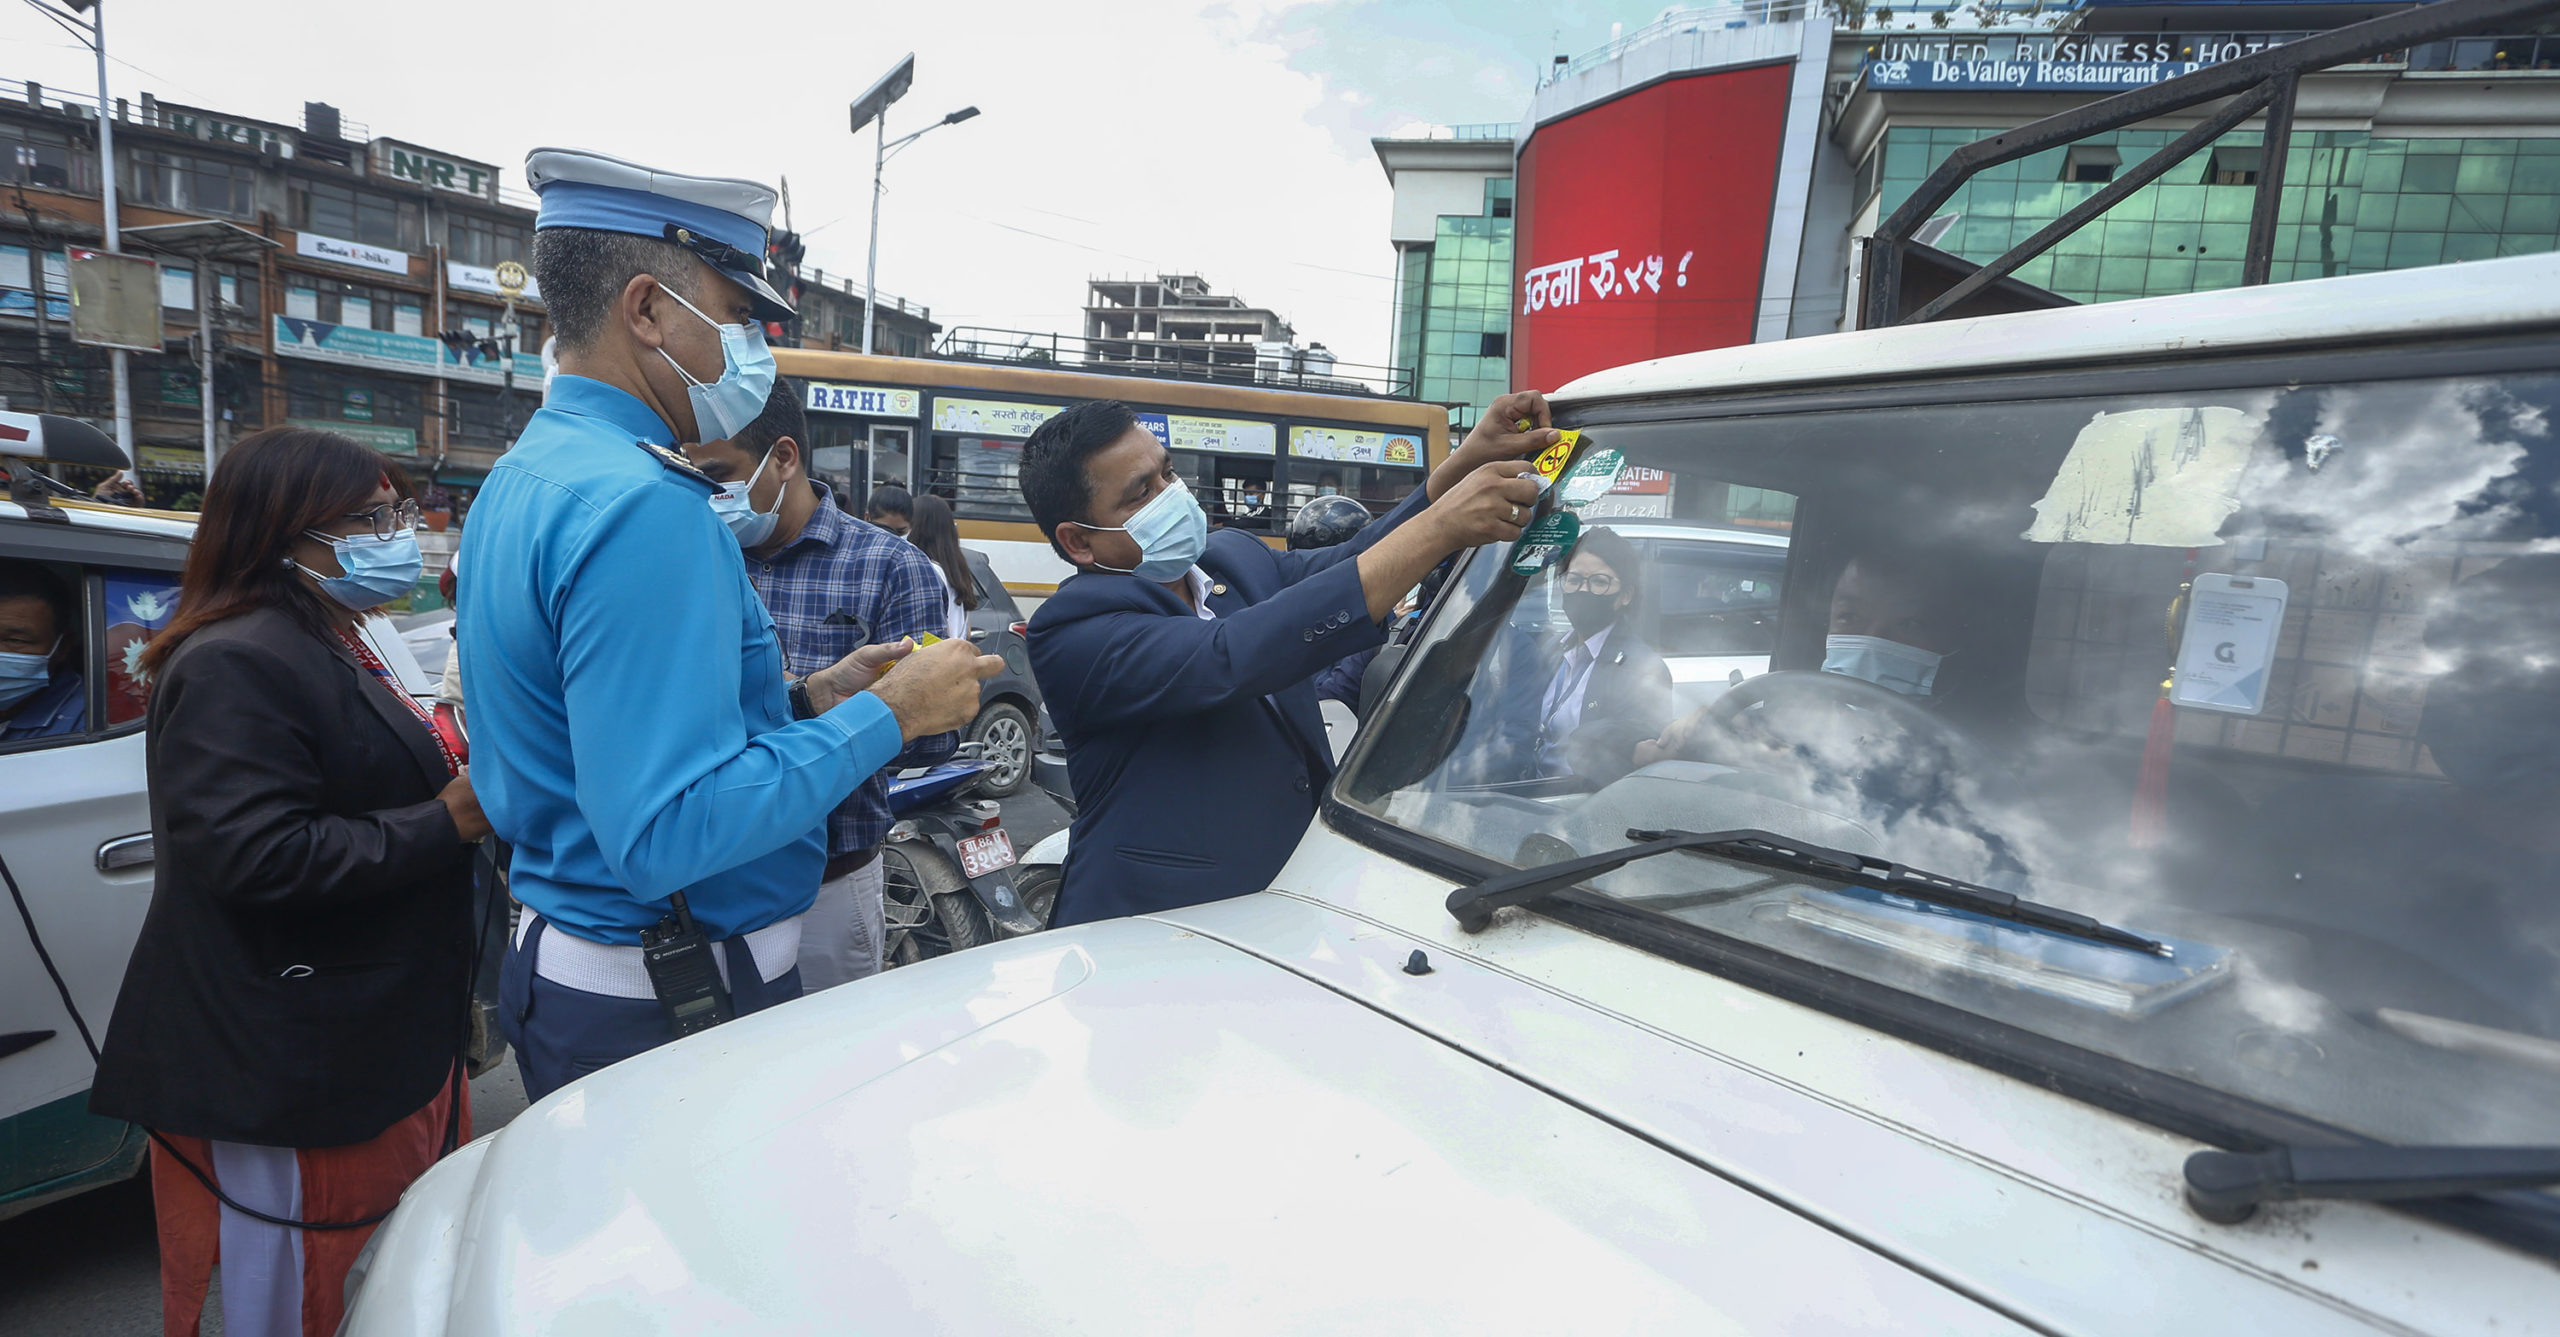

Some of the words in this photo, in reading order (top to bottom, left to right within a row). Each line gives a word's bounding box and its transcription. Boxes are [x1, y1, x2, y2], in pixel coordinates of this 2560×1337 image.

[1881, 43, 1988, 62] UNITED
[2016, 44, 2170, 63] BUSINESS
[1931, 61, 2031, 87] De-Valley
[2037, 62, 2158, 82] Restaurant
[392, 149, 488, 194] NRT
[813, 387, 886, 412] RATHI
[1614, 503, 1657, 518] PIZZA
